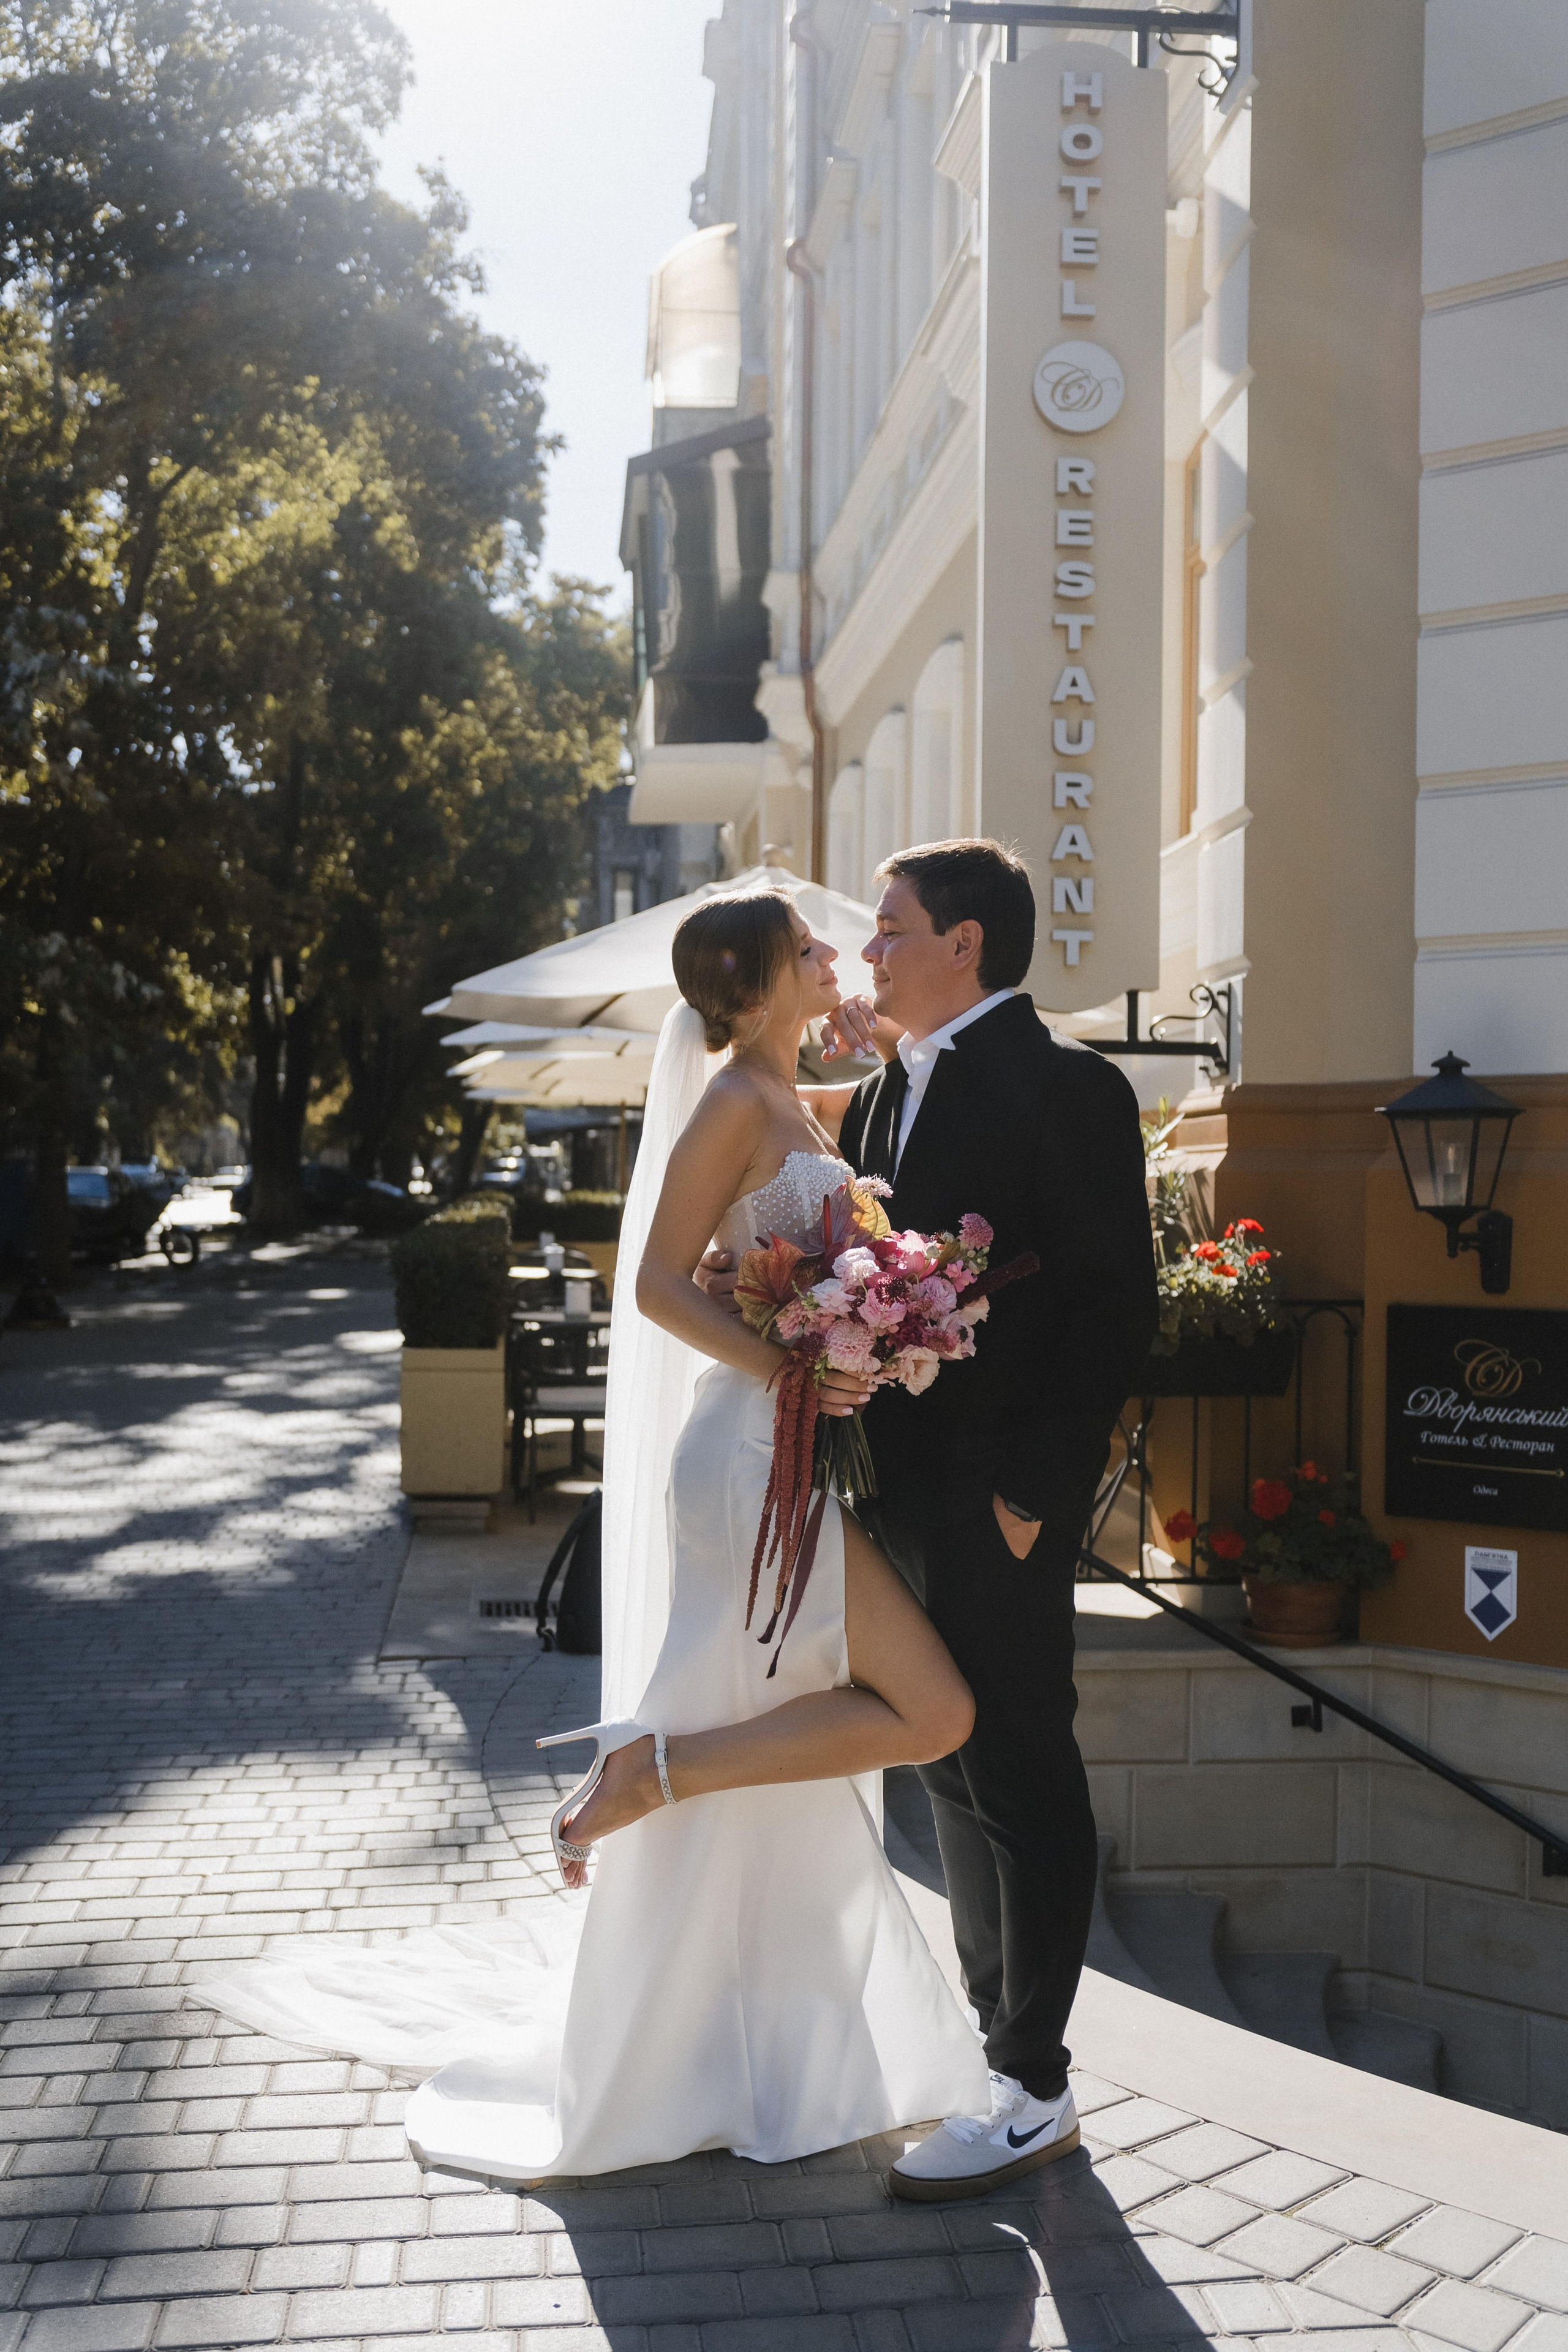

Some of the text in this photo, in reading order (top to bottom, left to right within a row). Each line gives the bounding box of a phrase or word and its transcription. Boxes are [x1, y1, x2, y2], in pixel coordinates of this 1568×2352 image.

[1060, 71, 1102, 320] HOTEL
[1052, 456, 1096, 966] RESTAURANT
[1403, 1386, 1568, 1434] Дворянський
[1420, 1431, 1555, 1455] Готель & Ресторан
[1472, 1485, 1499, 1496] Одеса
